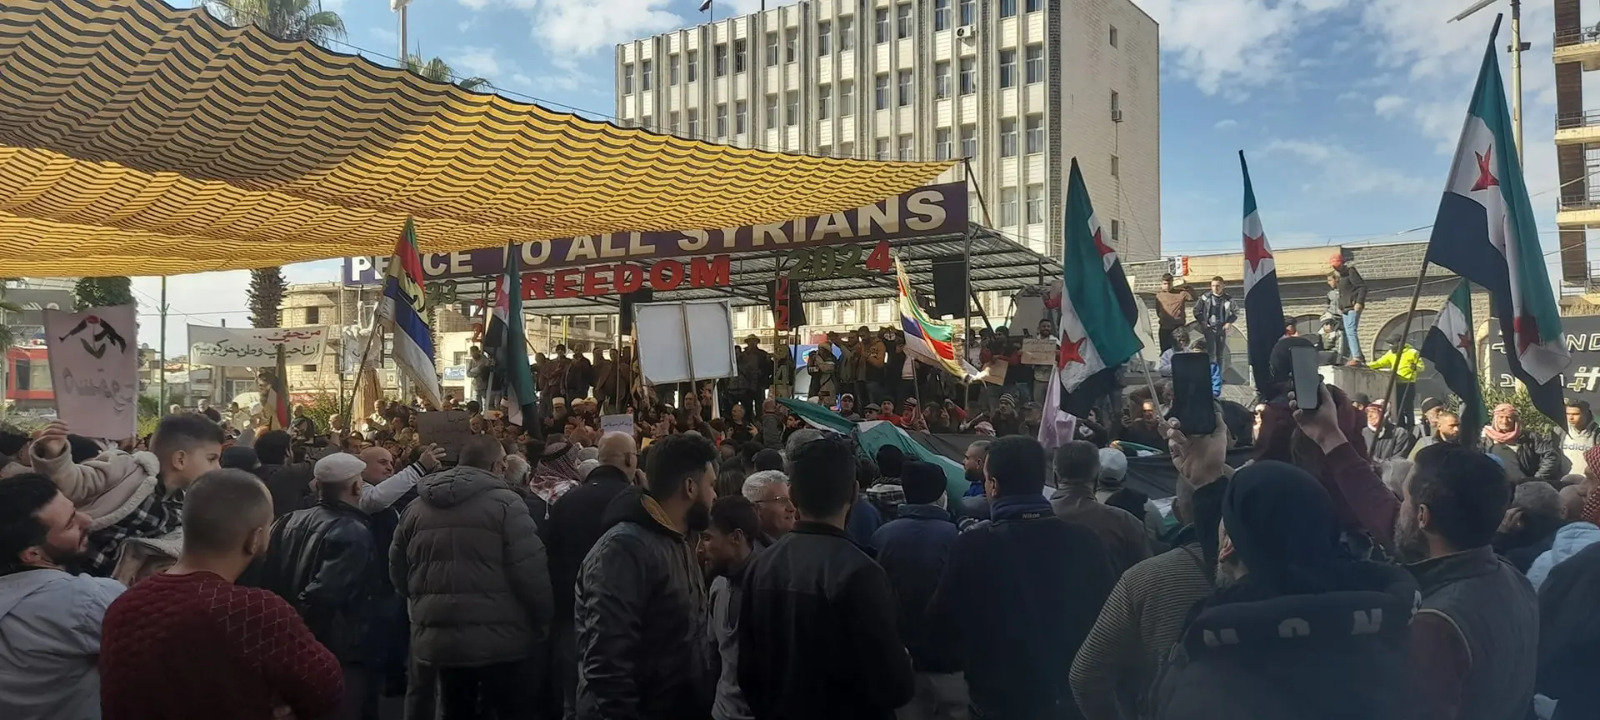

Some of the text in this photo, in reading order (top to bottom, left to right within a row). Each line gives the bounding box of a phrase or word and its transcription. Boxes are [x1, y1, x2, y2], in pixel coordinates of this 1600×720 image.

[352, 251, 473, 282] PECE
[566, 230, 656, 263] ALL
[677, 189, 948, 249] SYRIANS
[788, 239, 892, 280] 2024
